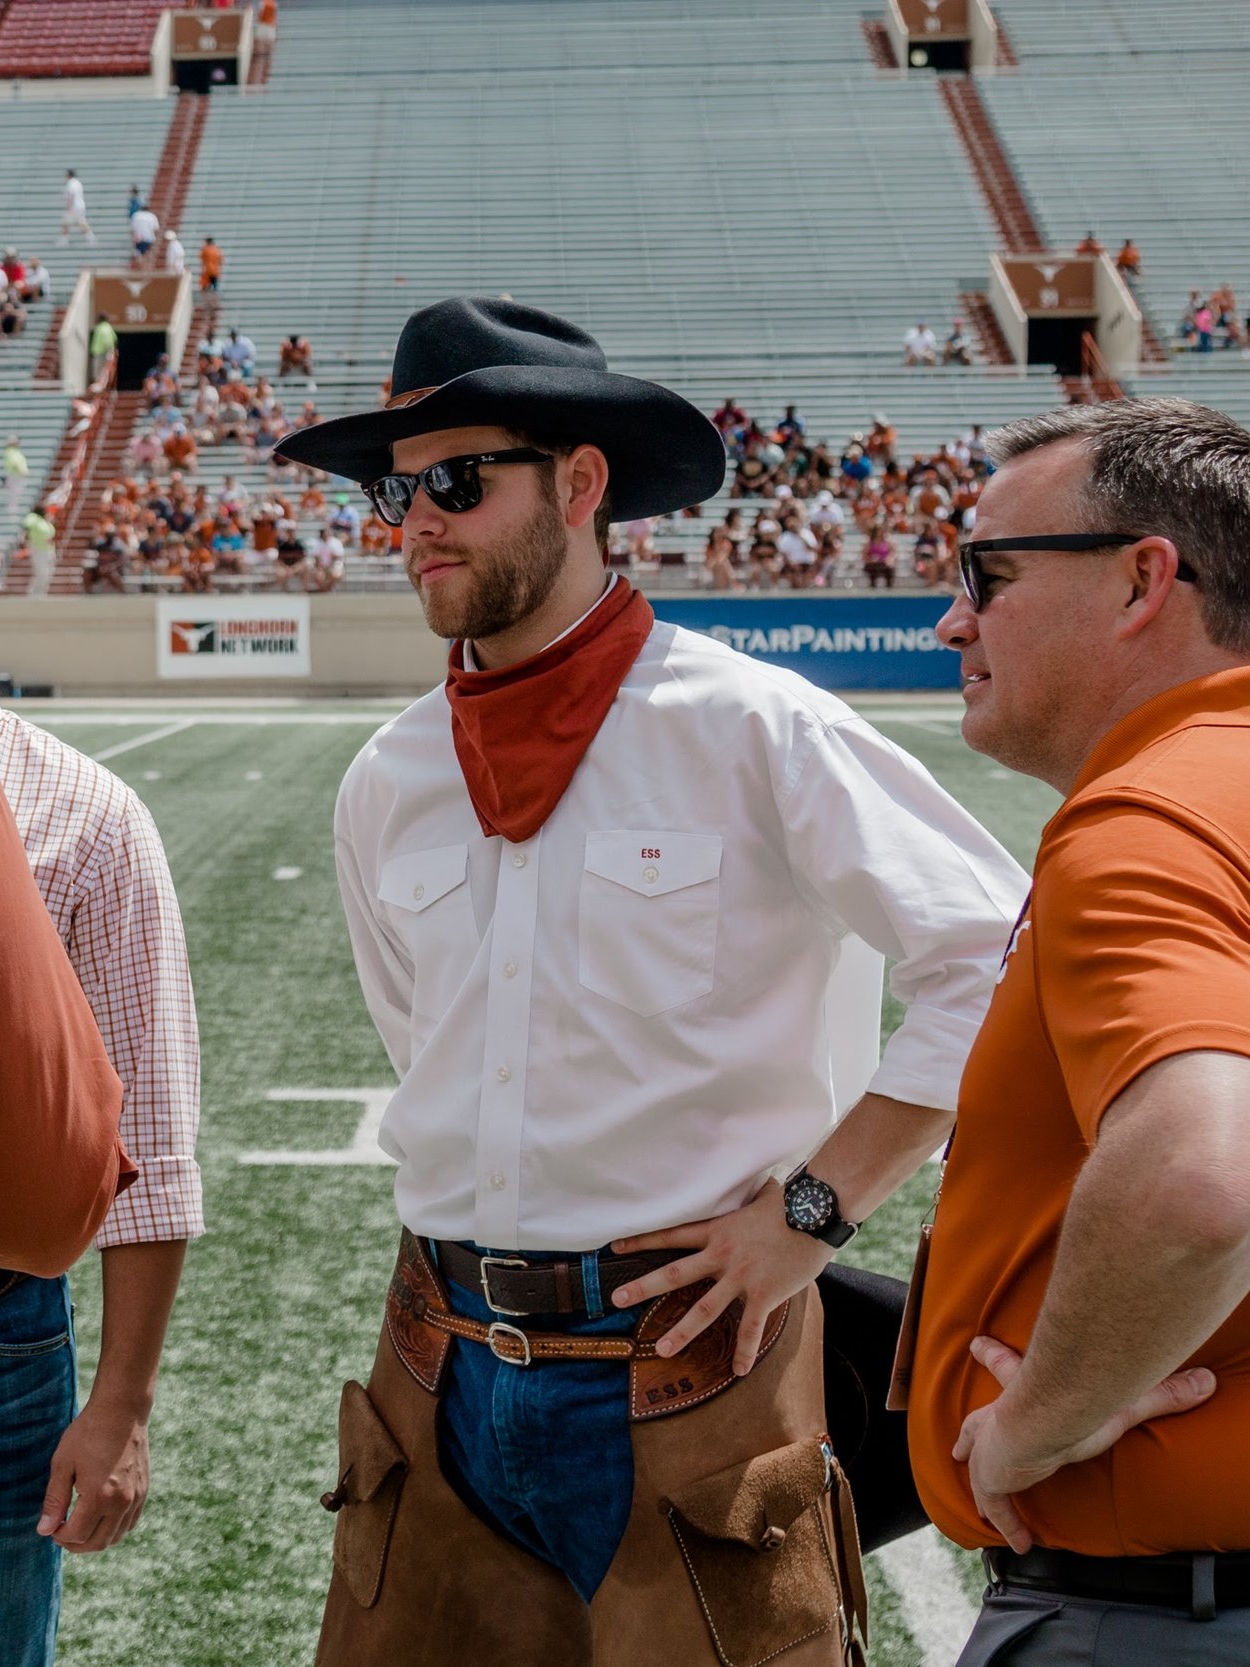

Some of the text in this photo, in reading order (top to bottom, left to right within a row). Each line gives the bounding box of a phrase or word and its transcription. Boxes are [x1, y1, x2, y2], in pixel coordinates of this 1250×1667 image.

[219, 620, 298, 635] LONGHORN
[220, 638, 299, 653] NETWORK
[641, 848, 661, 859] ESS
[645, 1378, 694, 1404] ESS
